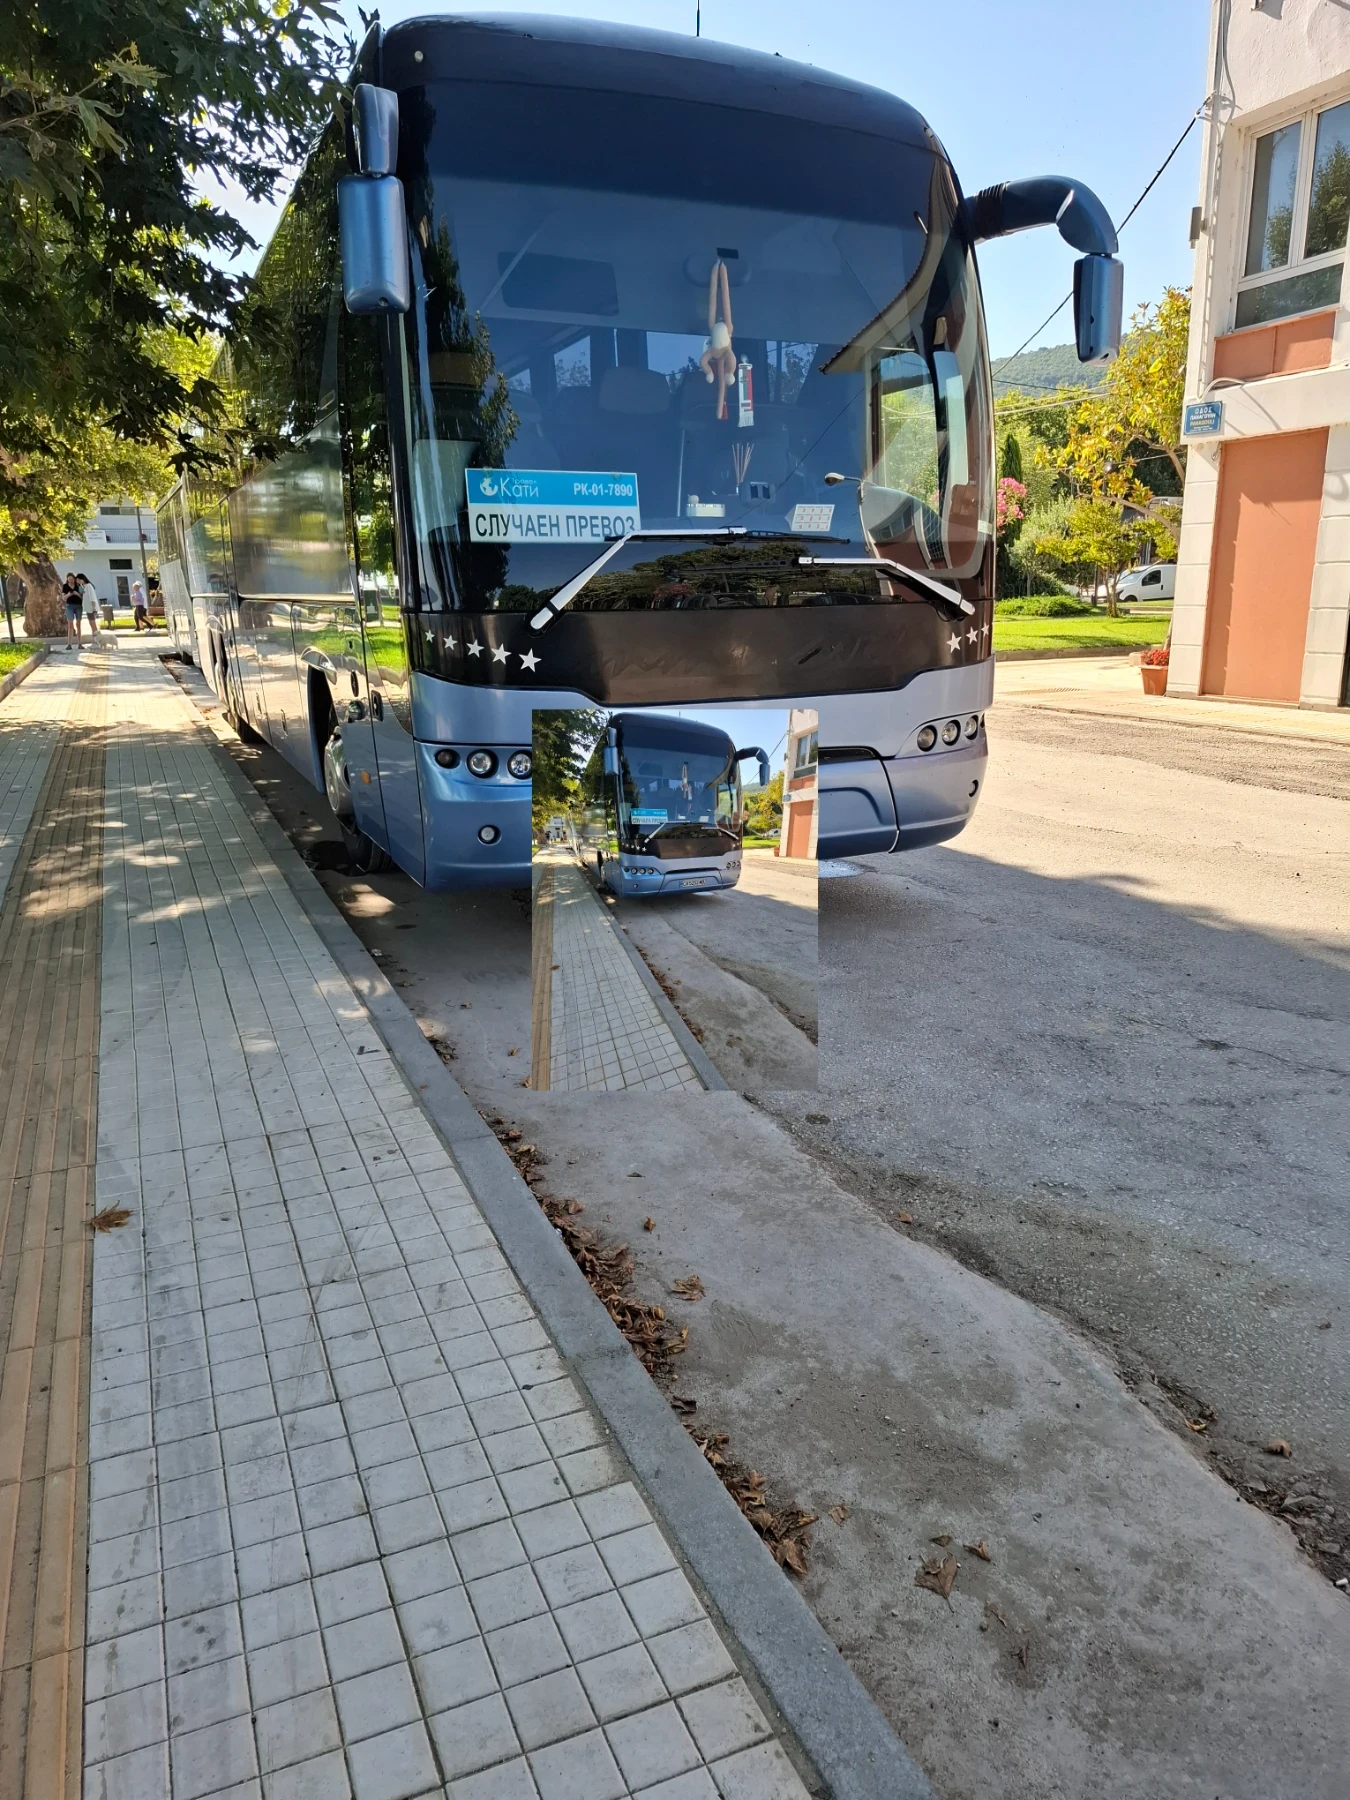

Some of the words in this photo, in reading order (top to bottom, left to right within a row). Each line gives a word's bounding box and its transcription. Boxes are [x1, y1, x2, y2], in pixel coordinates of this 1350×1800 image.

[1195, 406, 1212, 414] ΟΔΟΣ
[500, 477, 539, 498] Кати
[573, 483, 633, 497] РК-01-7890
[475, 513, 560, 537] СЛУЧАЕН
[566, 515, 635, 538] ПРЕВОЗ
